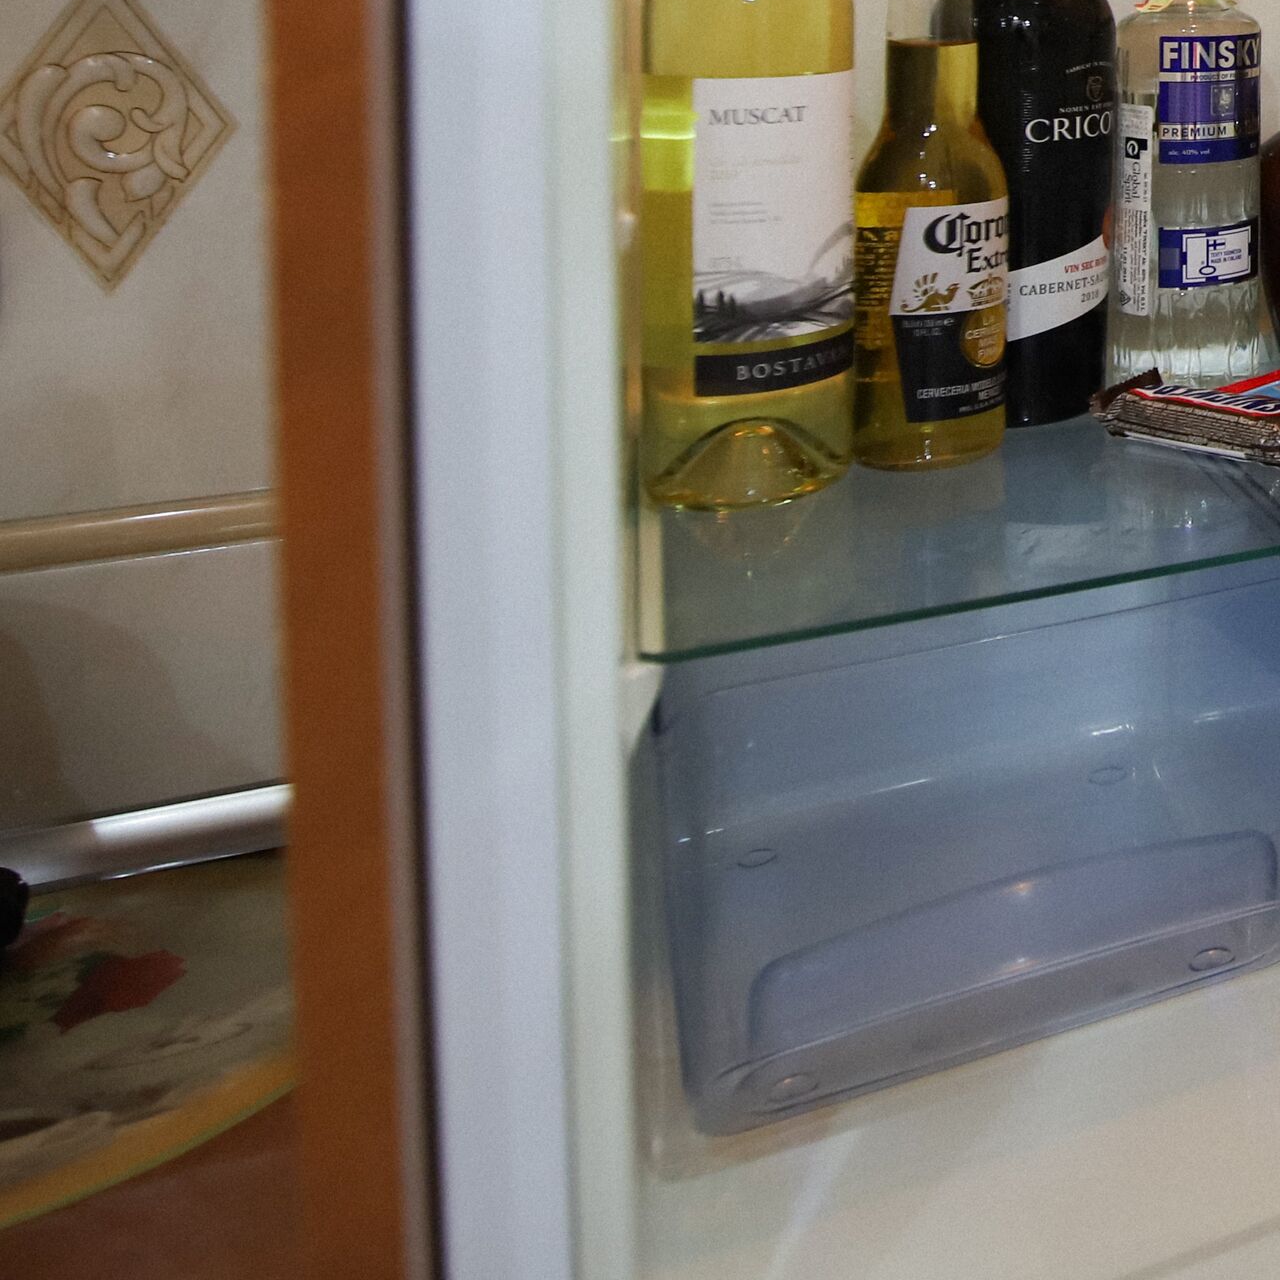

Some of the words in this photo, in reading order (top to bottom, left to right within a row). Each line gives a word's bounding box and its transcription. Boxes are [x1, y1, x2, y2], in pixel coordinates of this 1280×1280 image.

[1163, 38, 1259, 69] FINSKY
[707, 105, 808, 126] MUSCAT
[1025, 111, 1111, 143] CRICO
[1162, 126, 1227, 138] PREMIUM
[966, 247, 1008, 273] Extr
